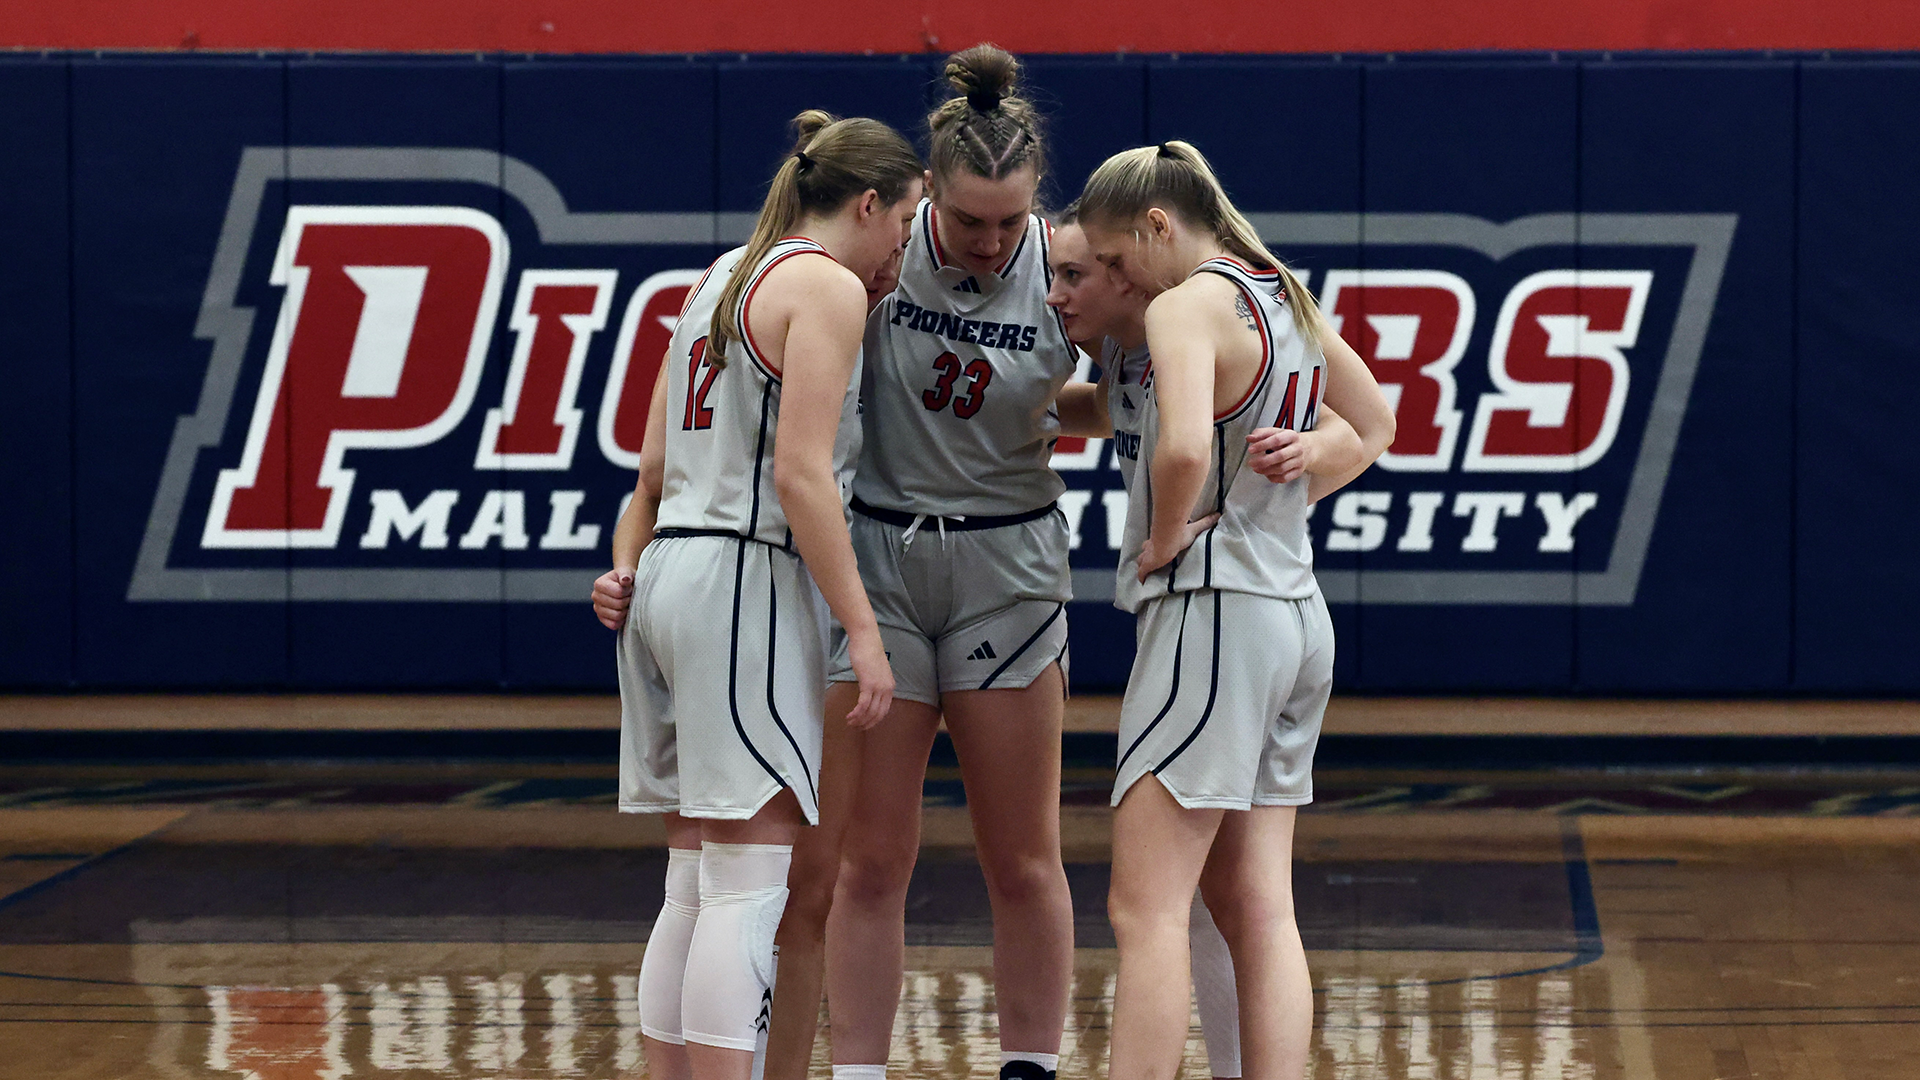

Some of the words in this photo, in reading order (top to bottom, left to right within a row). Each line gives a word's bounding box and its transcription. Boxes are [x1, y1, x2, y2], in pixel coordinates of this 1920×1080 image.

[891, 300, 1038, 352] PIONEERS
[682, 335, 720, 431] 12
[921, 350, 993, 420] 33
